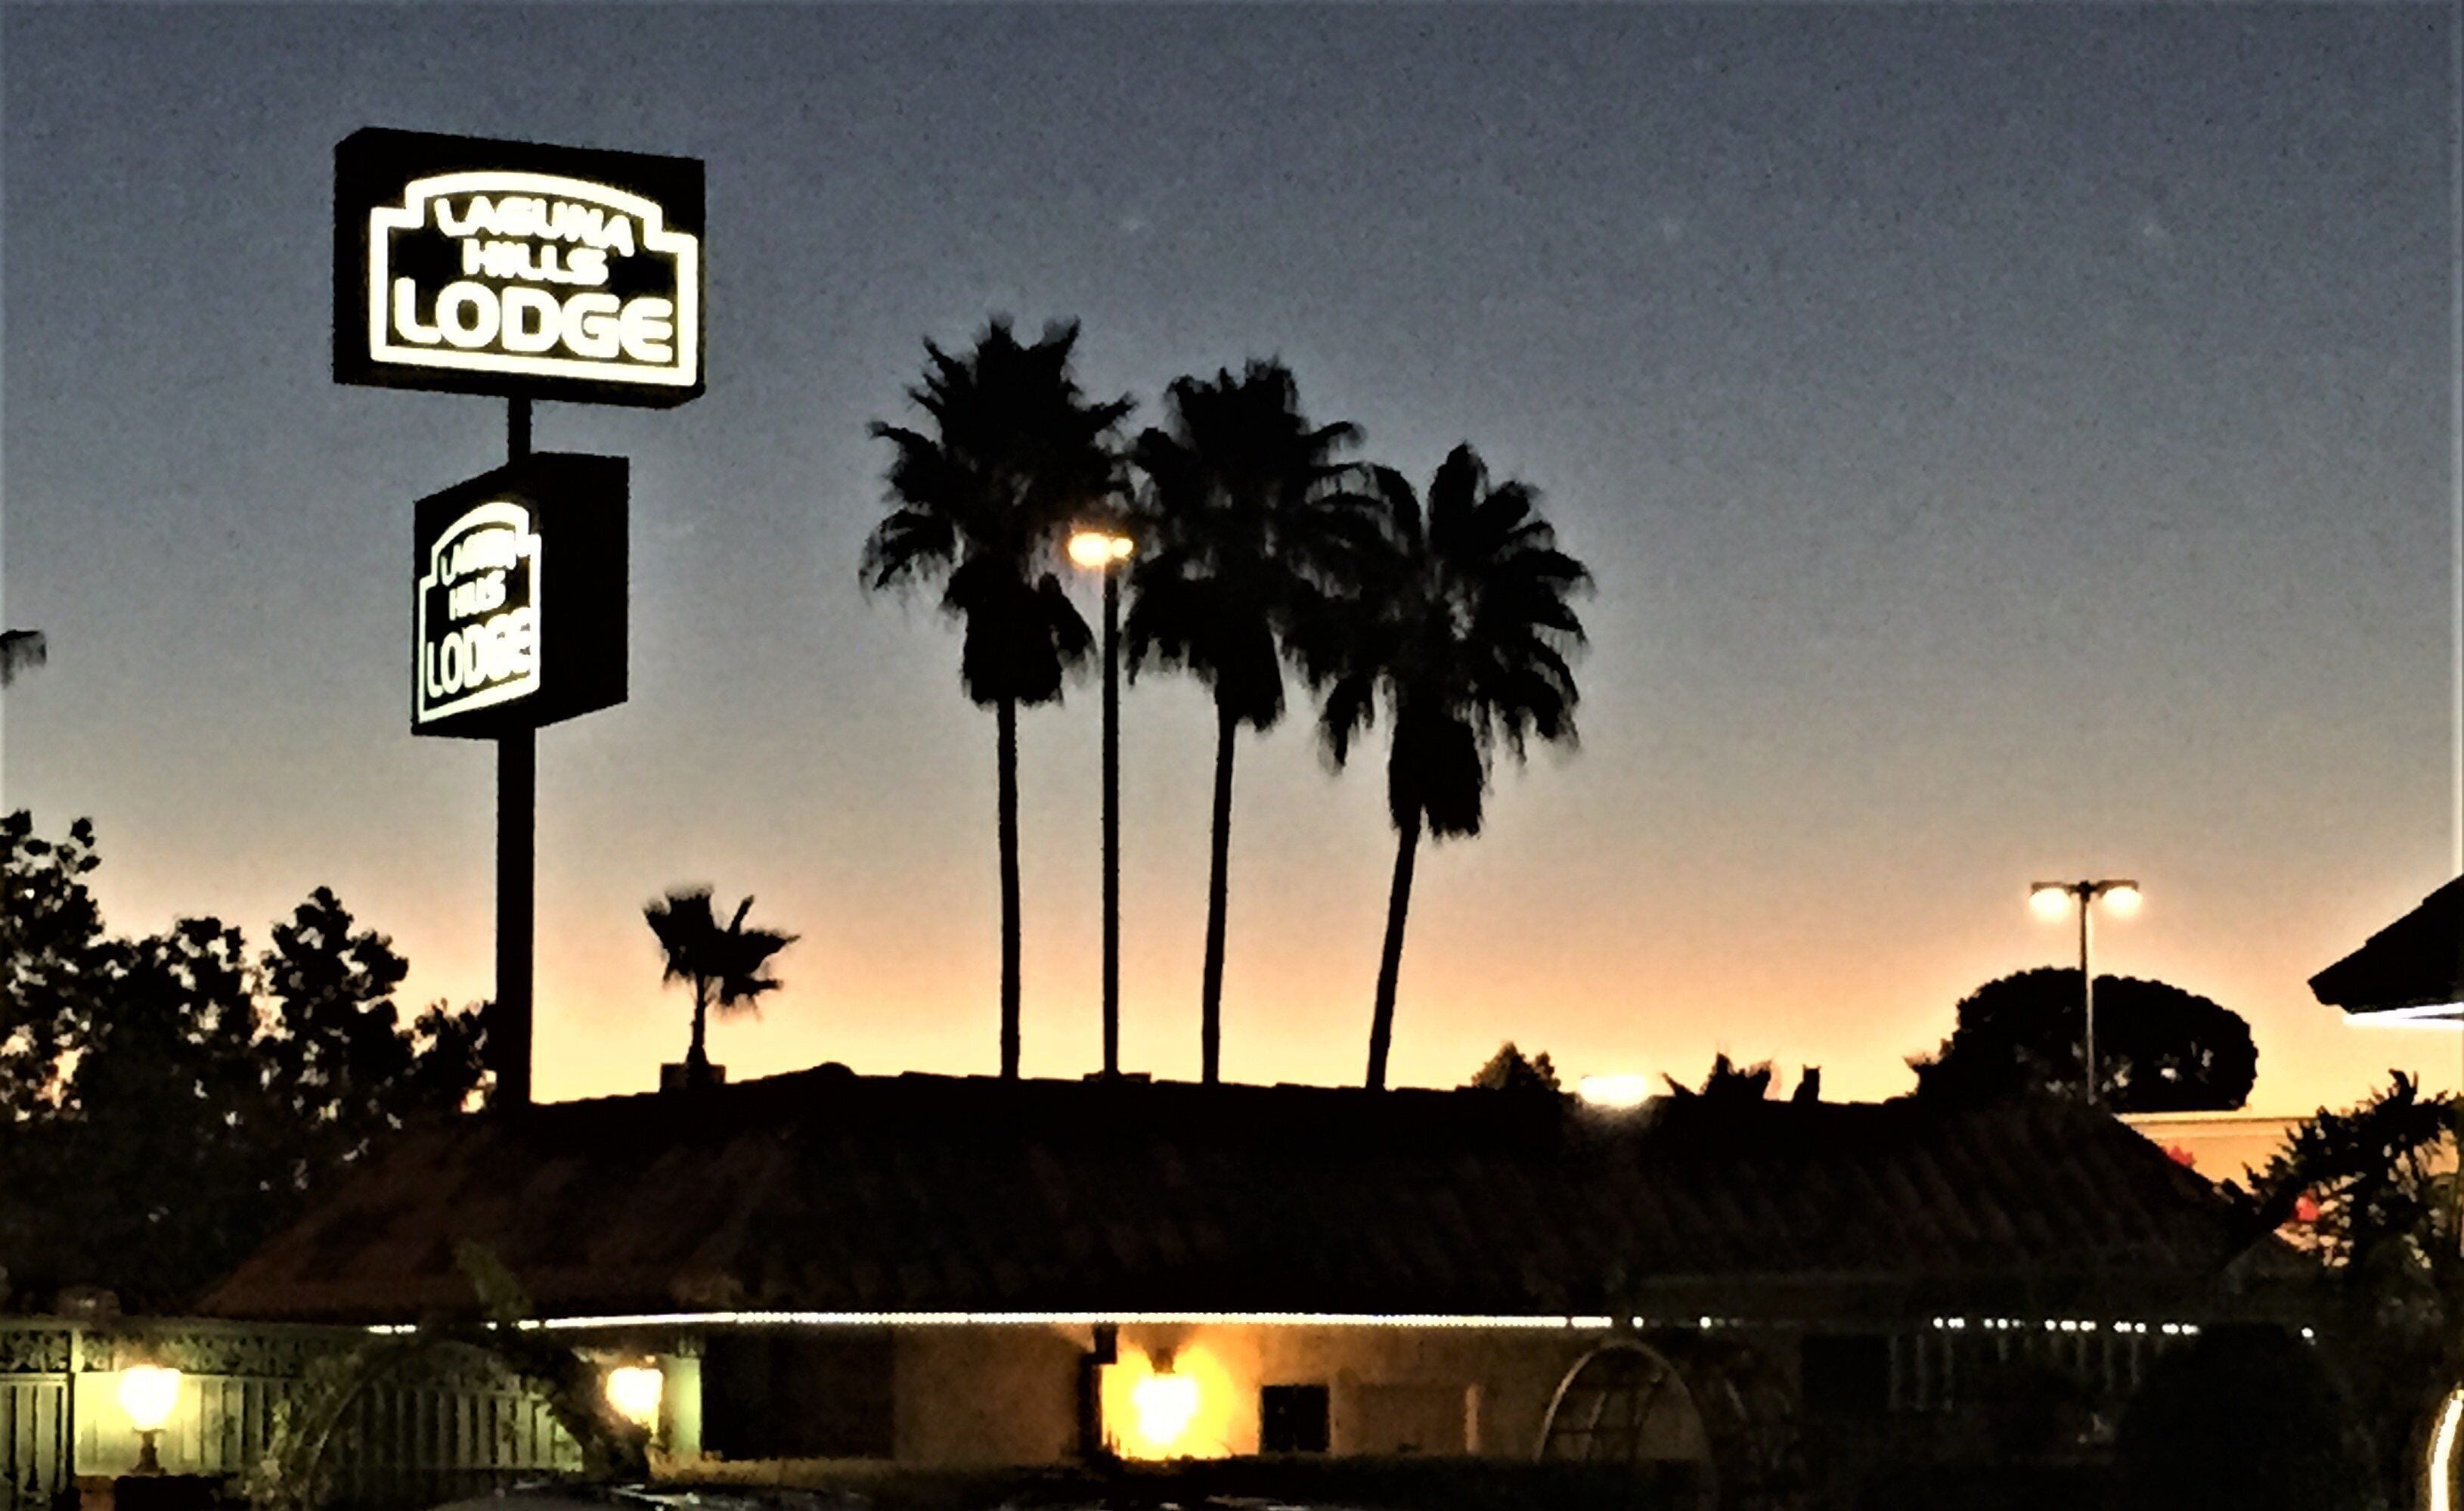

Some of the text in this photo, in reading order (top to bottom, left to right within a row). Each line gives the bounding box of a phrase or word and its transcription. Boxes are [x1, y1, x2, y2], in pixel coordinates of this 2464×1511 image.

[435, 196, 634, 257] LAGUNA
[463, 238, 609, 285] HILLS
[394, 277, 673, 362] LODGE
[441, 528, 516, 586] LAG
[427, 607, 531, 698] LODGE
